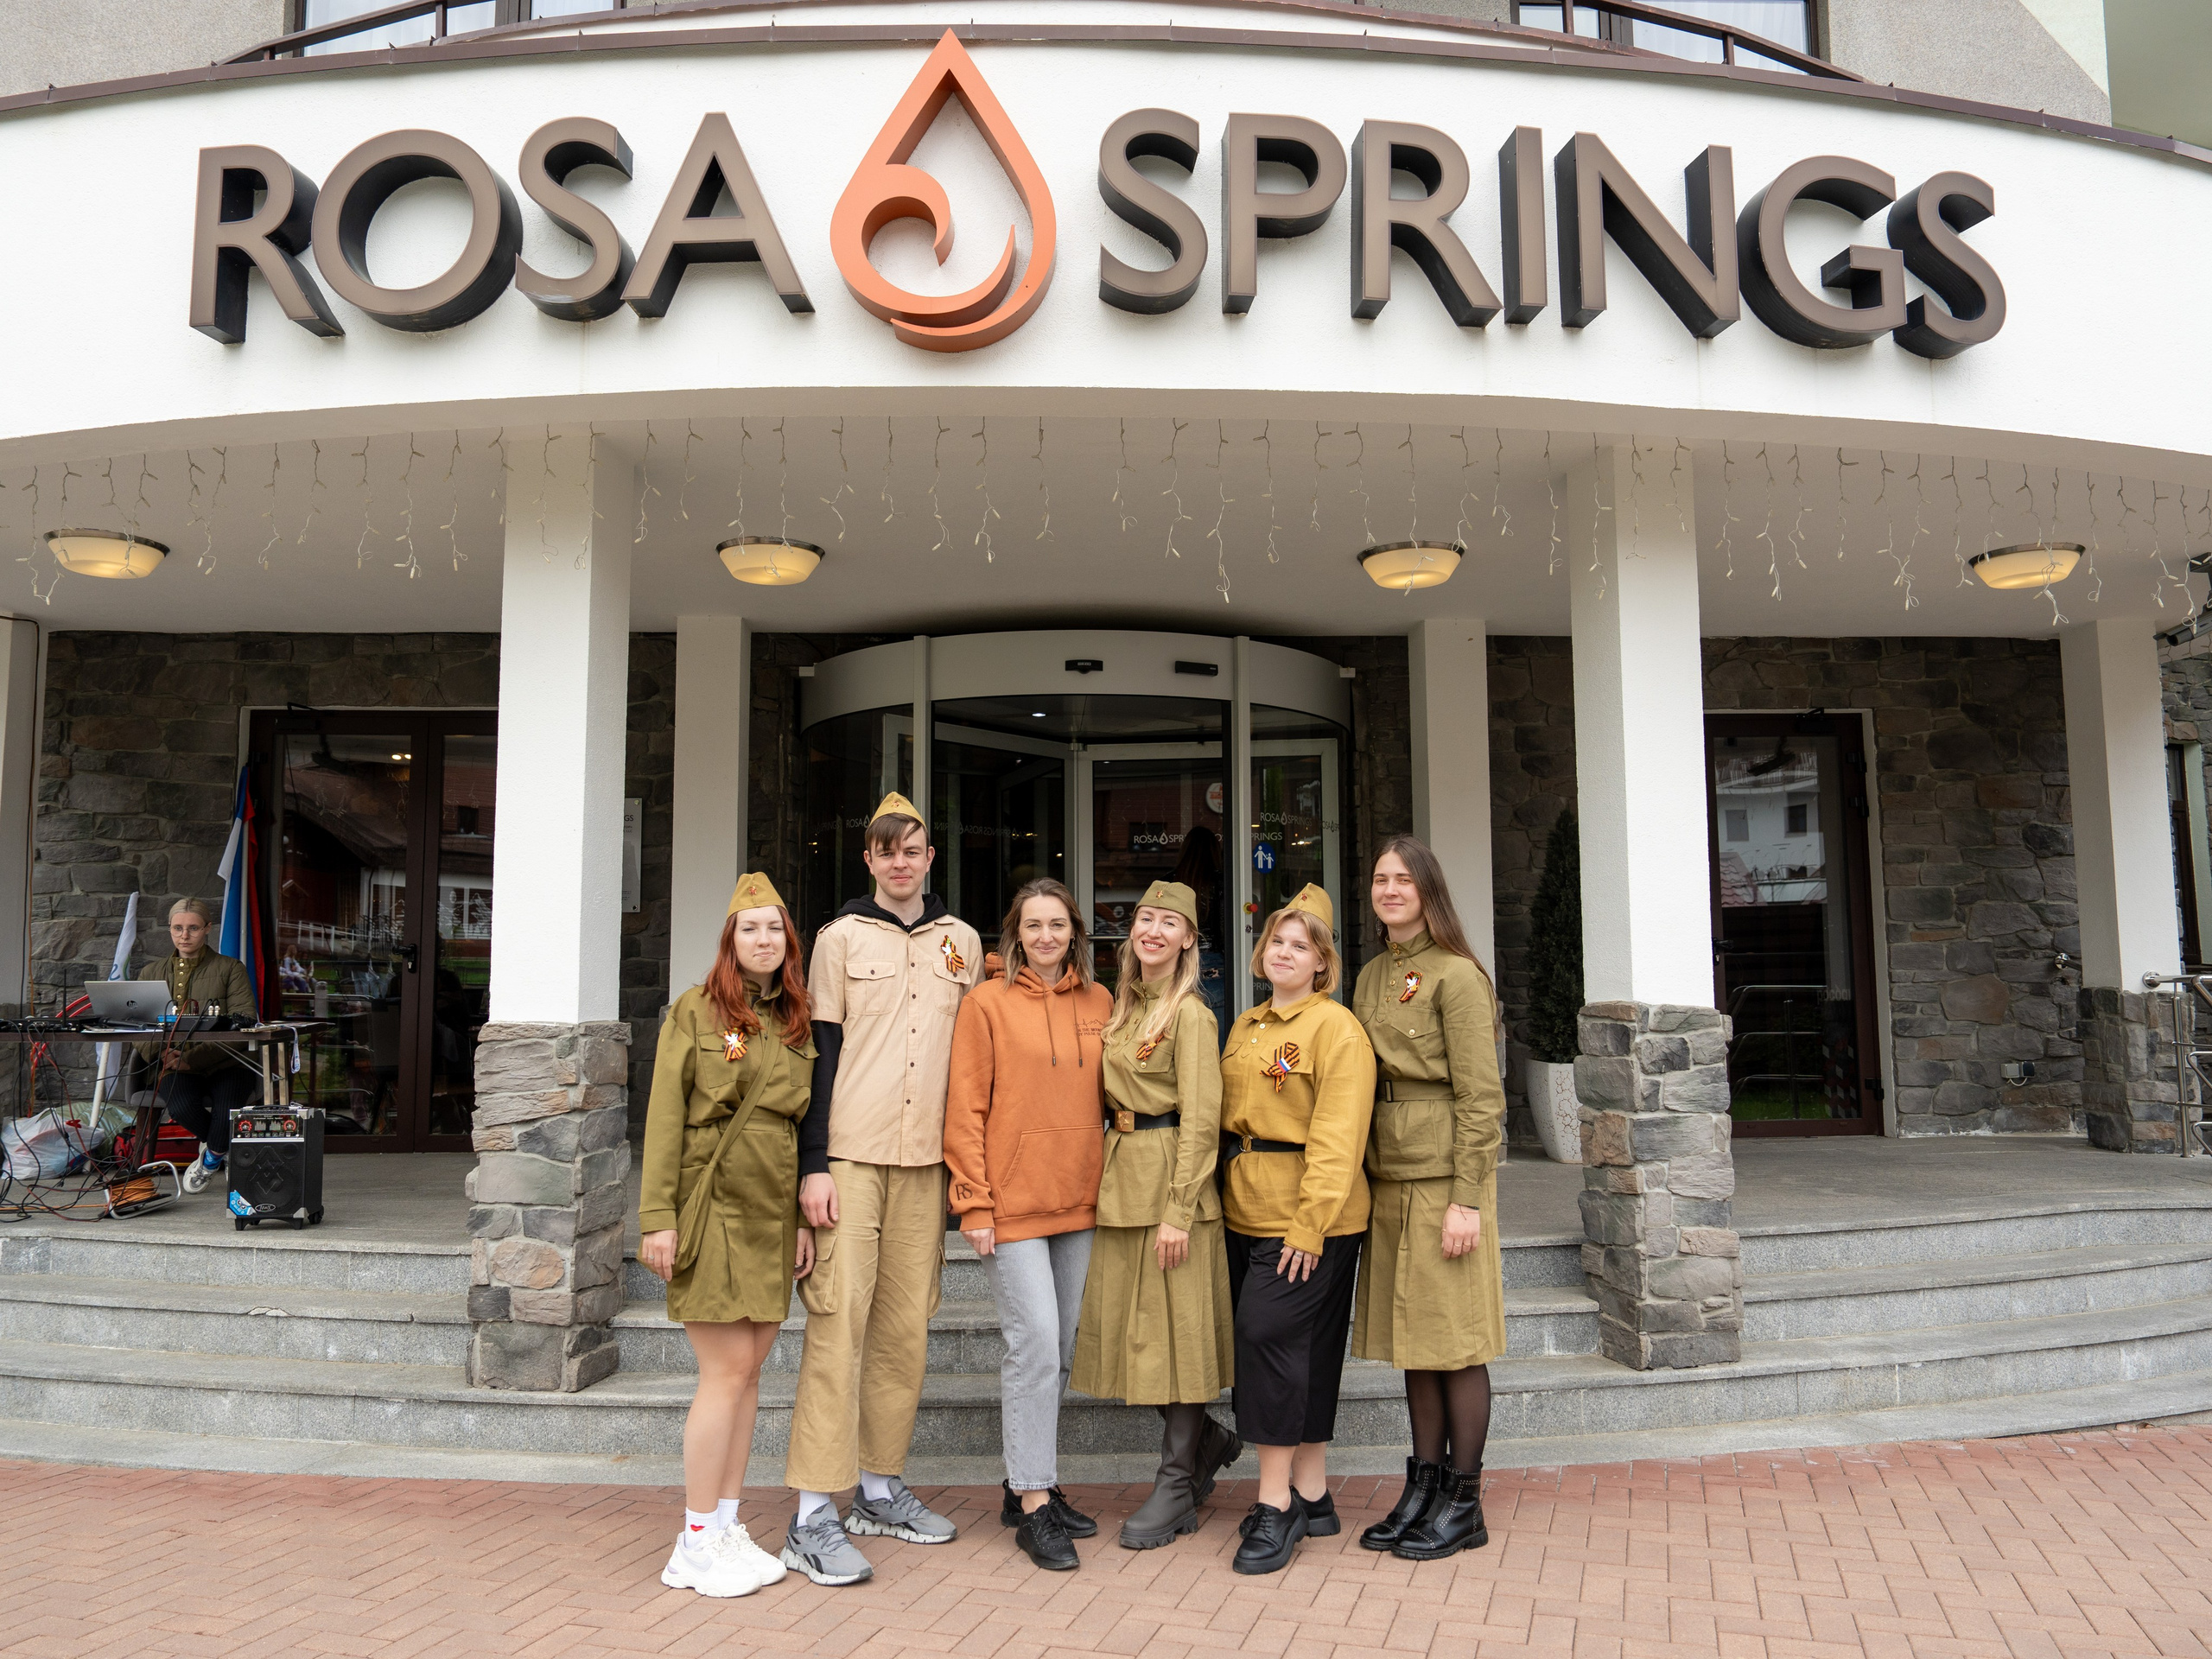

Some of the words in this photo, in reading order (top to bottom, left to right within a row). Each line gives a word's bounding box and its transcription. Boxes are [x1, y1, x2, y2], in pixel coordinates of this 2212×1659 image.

[189, 111, 816, 344] ROSA
[1098, 107, 2006, 360] SPRINGS
[846, 817, 863, 829] ROSA
[1260, 811, 1281, 823] ROSA
[1287, 814, 1313, 827] SPRINGS
[1134, 835, 1159, 844] ROSA
[1168, 834, 1185, 842] SPR
[1251, 831, 1283, 841] PRINGS
[955, 1183, 973, 1201] RS
